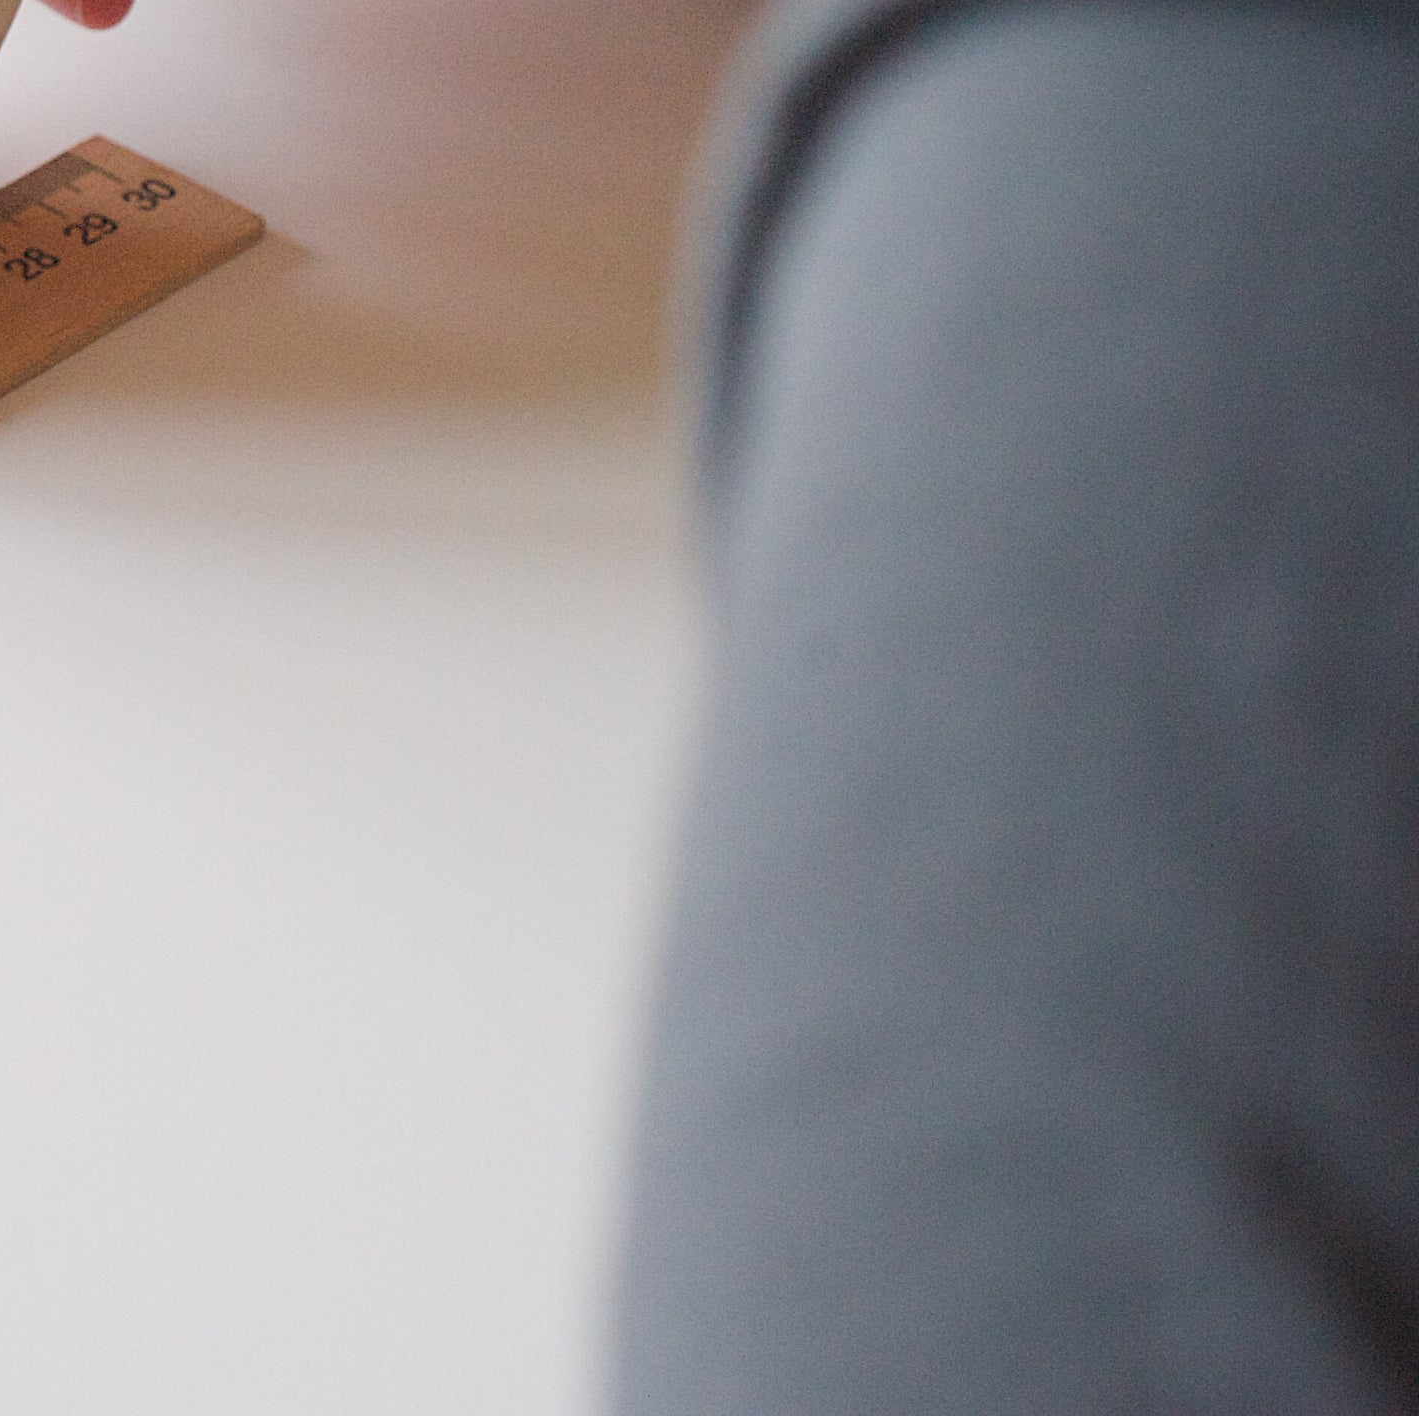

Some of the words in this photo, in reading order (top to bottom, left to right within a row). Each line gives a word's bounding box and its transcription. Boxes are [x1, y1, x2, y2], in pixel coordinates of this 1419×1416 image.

[4, 247, 60, 281] 28
[64, 213, 118, 246] 29
[122, 178, 176, 211] 30
